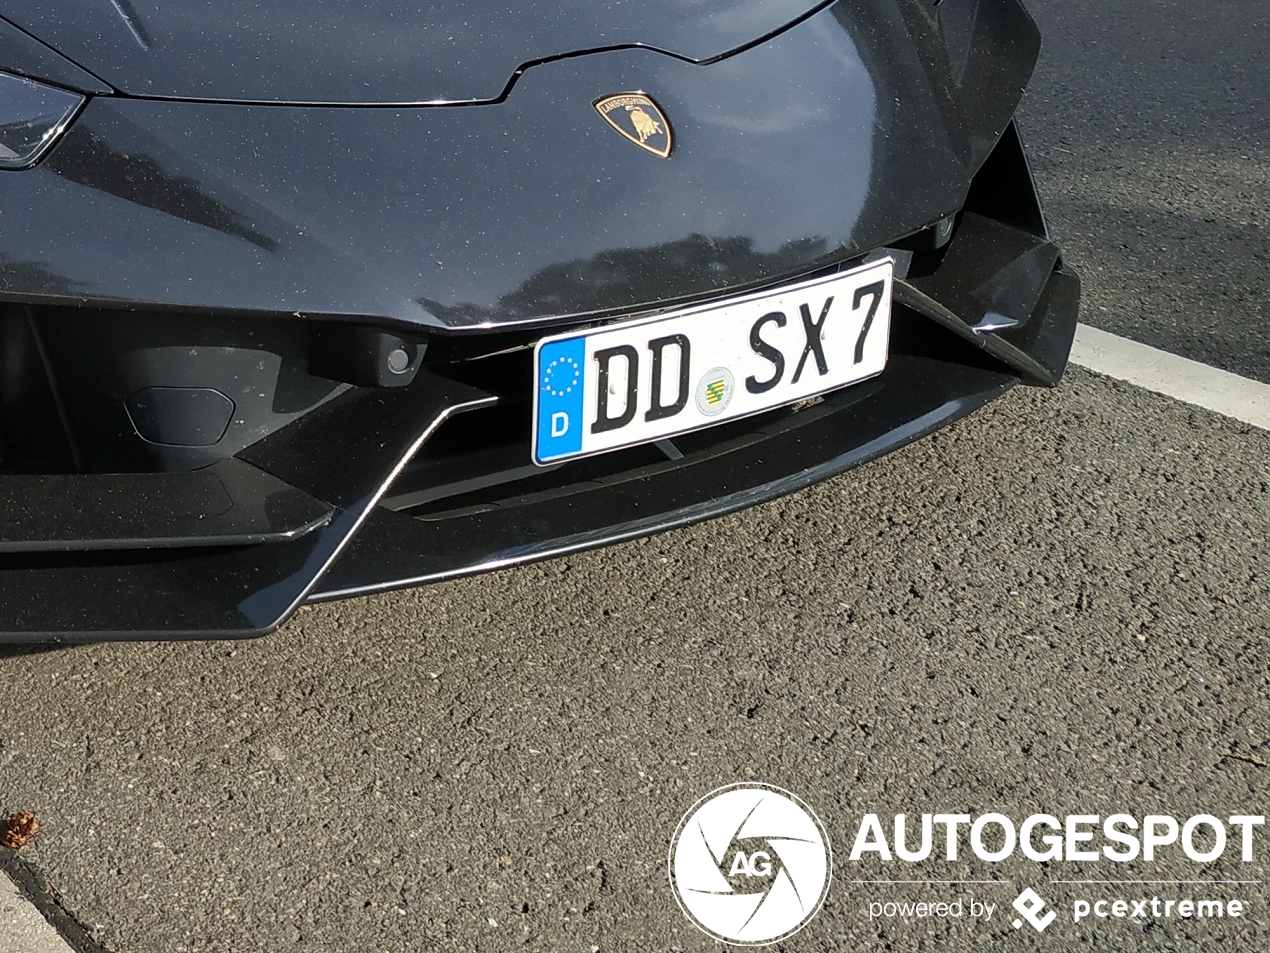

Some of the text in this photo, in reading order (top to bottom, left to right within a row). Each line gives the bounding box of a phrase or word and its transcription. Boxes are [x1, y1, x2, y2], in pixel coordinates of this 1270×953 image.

[599, 96, 651, 114] LAMBORGHINI
[590, 333, 690, 434] DD
[744, 295, 835, 395] SX
[851, 279, 885, 366] 7
[550, 411, 570, 438] D
